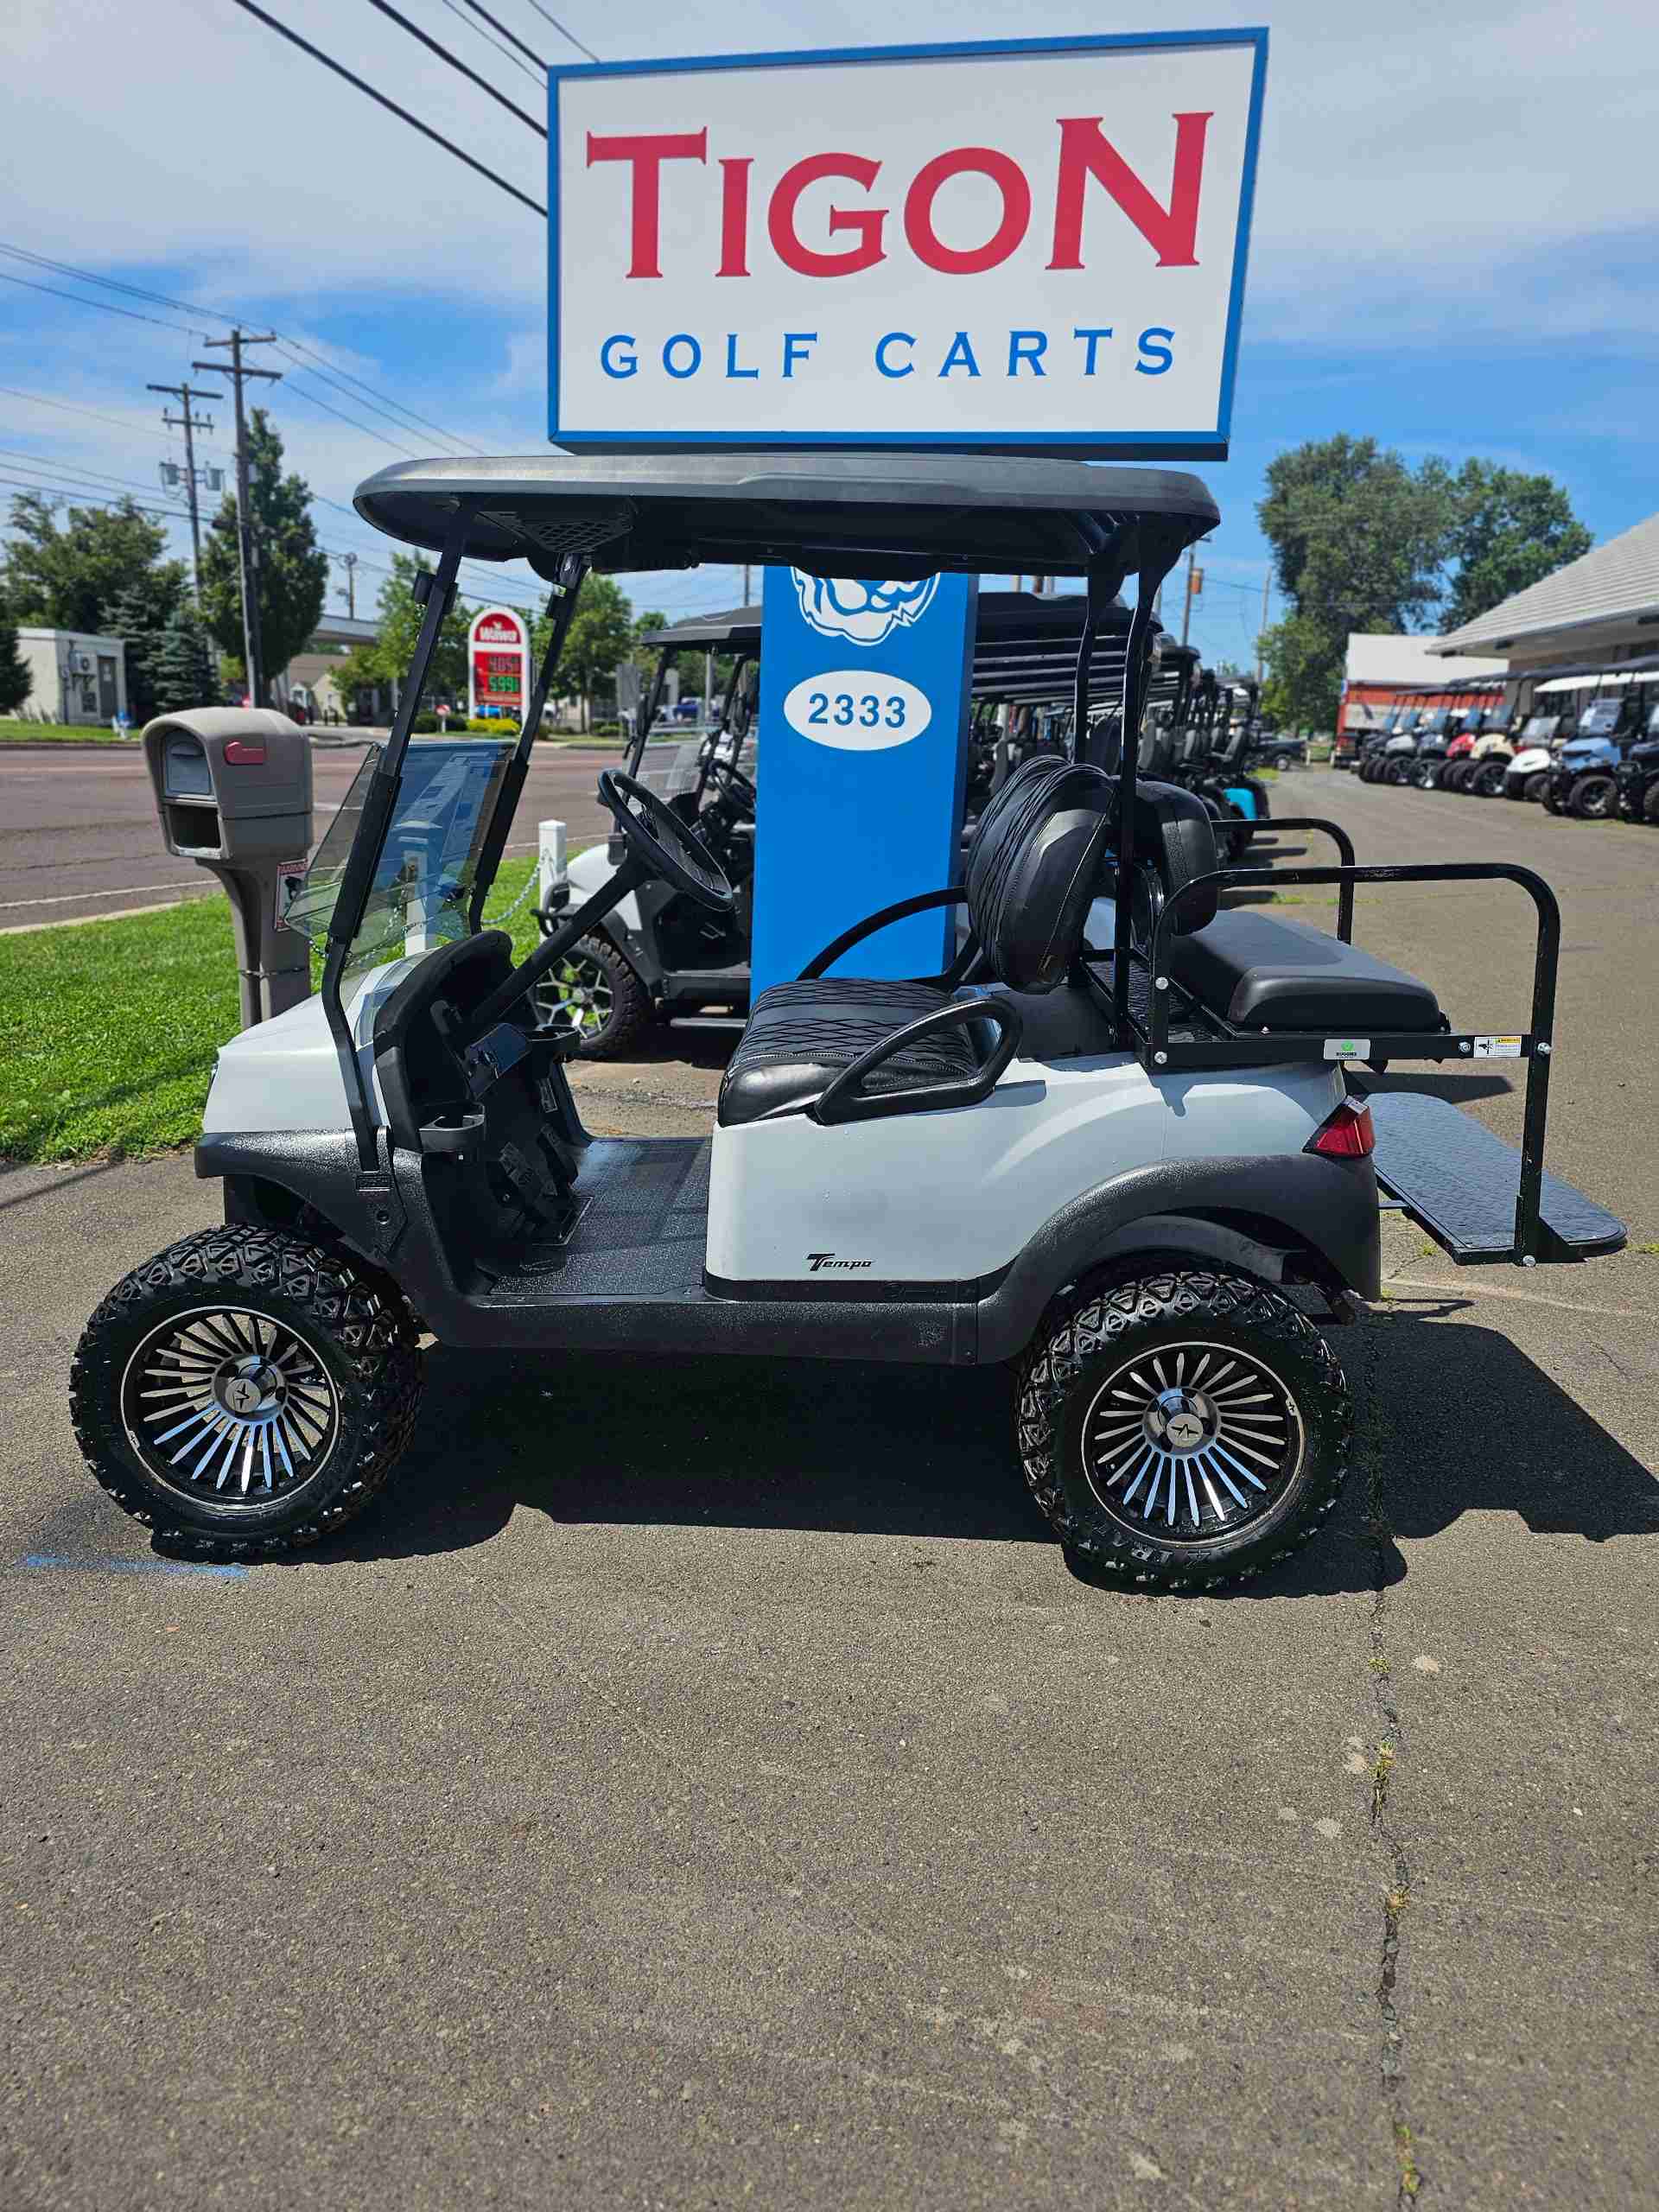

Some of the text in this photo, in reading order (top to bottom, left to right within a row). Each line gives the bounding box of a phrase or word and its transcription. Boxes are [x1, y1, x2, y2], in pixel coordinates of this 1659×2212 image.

[588, 111, 1213, 278] TIGON
[601, 327, 1176, 378] GOLF CARTS
[808, 693, 906, 728] 2333
[807, 1253, 874, 1272] Tempo
